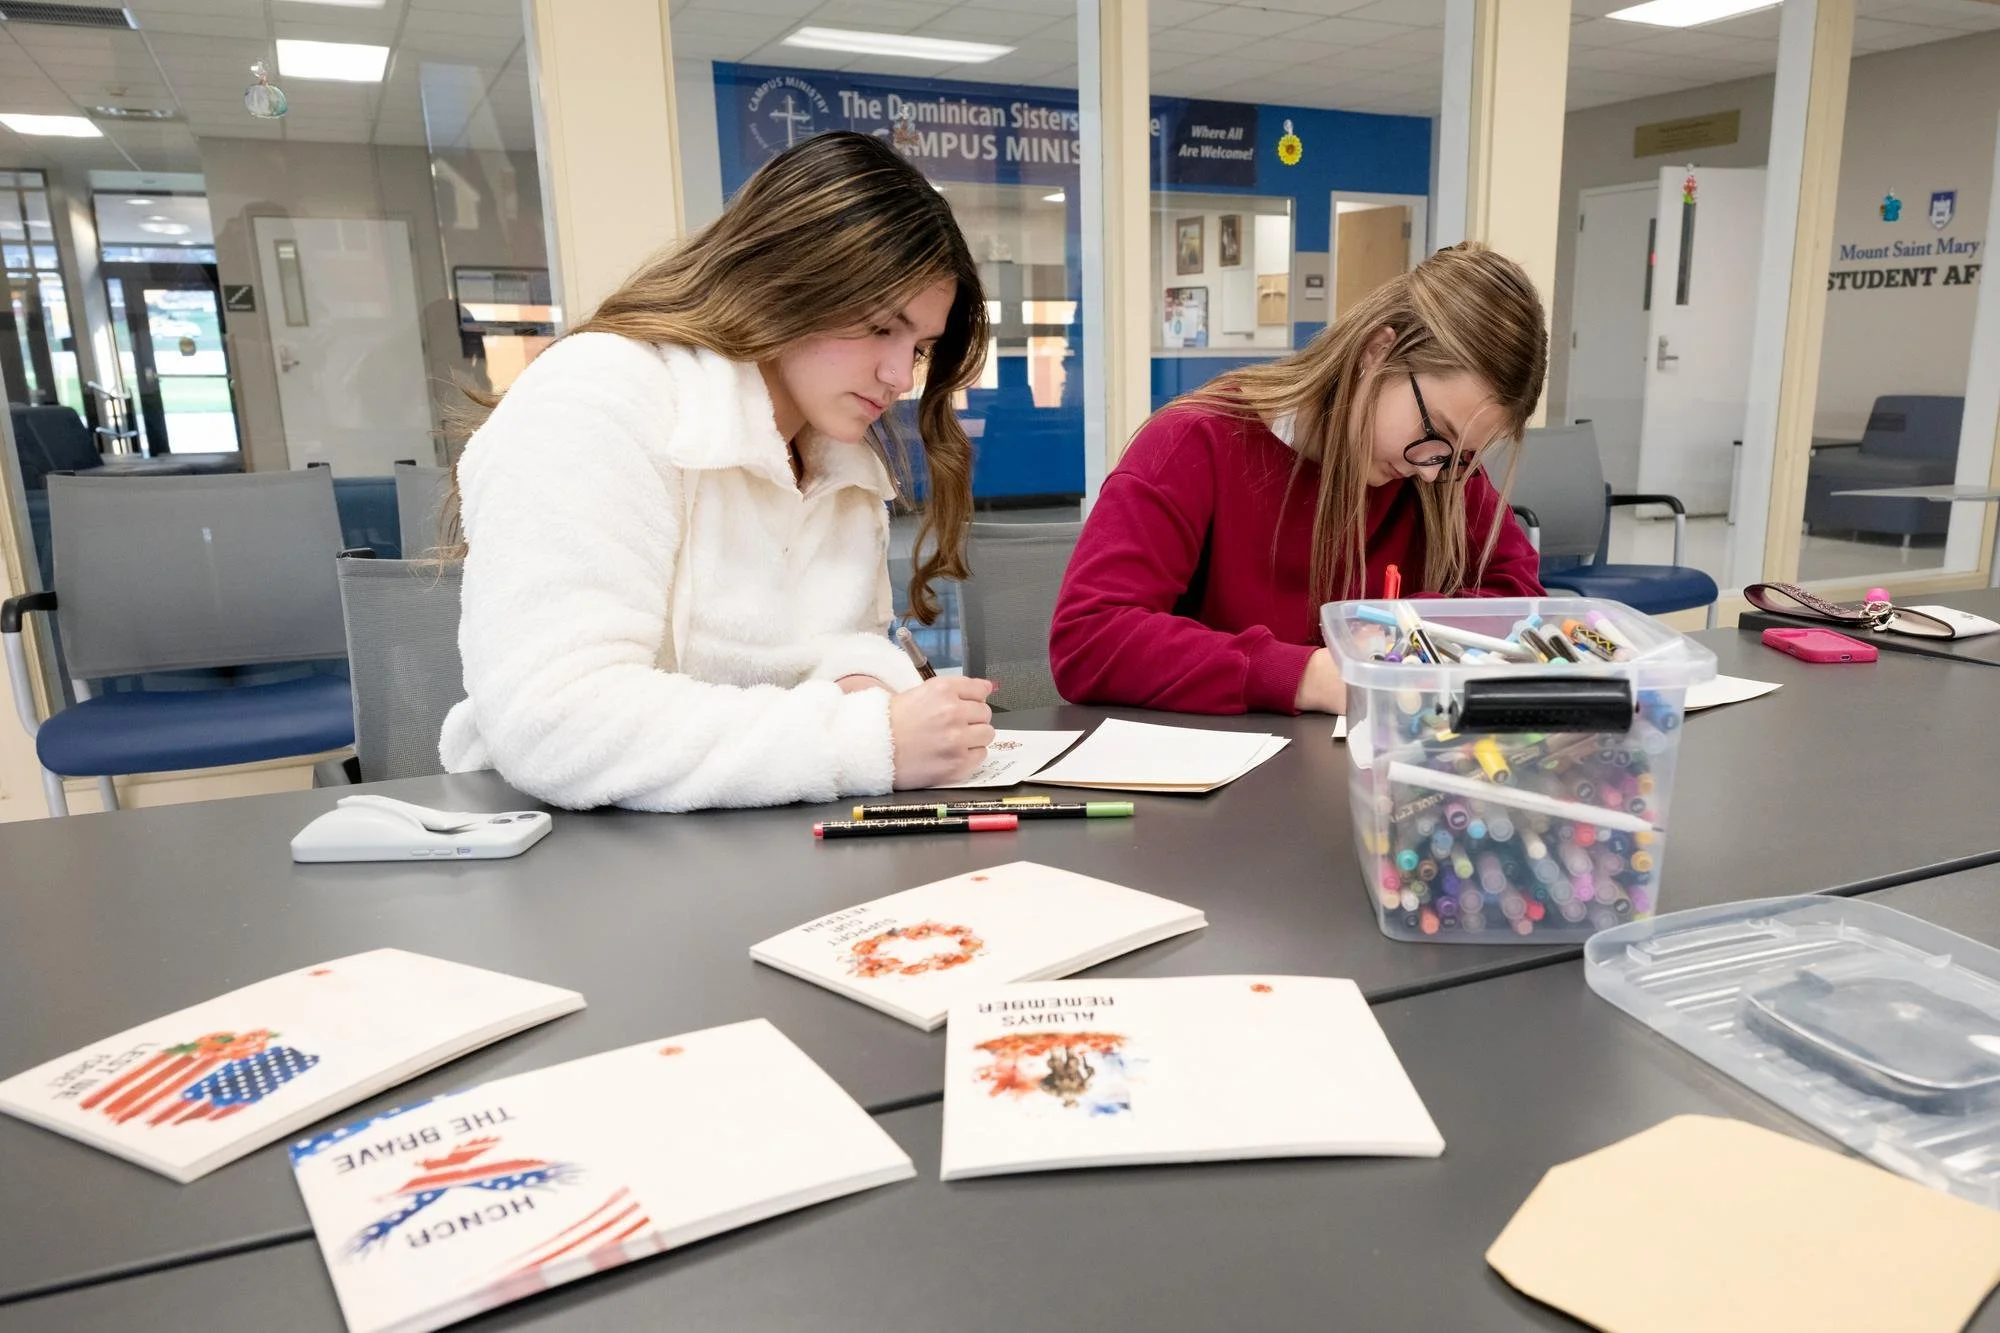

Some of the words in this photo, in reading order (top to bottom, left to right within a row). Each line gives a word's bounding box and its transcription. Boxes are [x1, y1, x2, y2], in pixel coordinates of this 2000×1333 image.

[748, 77, 784, 112] CAMPUS
[785, 76, 830, 114] MINISTRY
[838, 90, 882, 120] The
[888, 94, 1006, 128] Dominican
[1011, 102, 1080, 132] Sisters
[1191, 125, 1227, 140] Where
[1227, 127, 1243, 141] All
[1178, 144, 1199, 158] Are
[1201, 145, 1253, 161] Welcome!
[1840, 243, 1889, 261] Mount
[1893, 240, 1933, 258] Saint
[1943, 264, 1982, 286] AF
[978, 996, 1114, 1013] REMEMBER
[1002, 1012, 1095, 1027] ALWAYS
[450, 1106, 516, 1136] THE
[332, 1126, 441, 1175] BRAVE
[406, 1196, 536, 1248] HONOR
